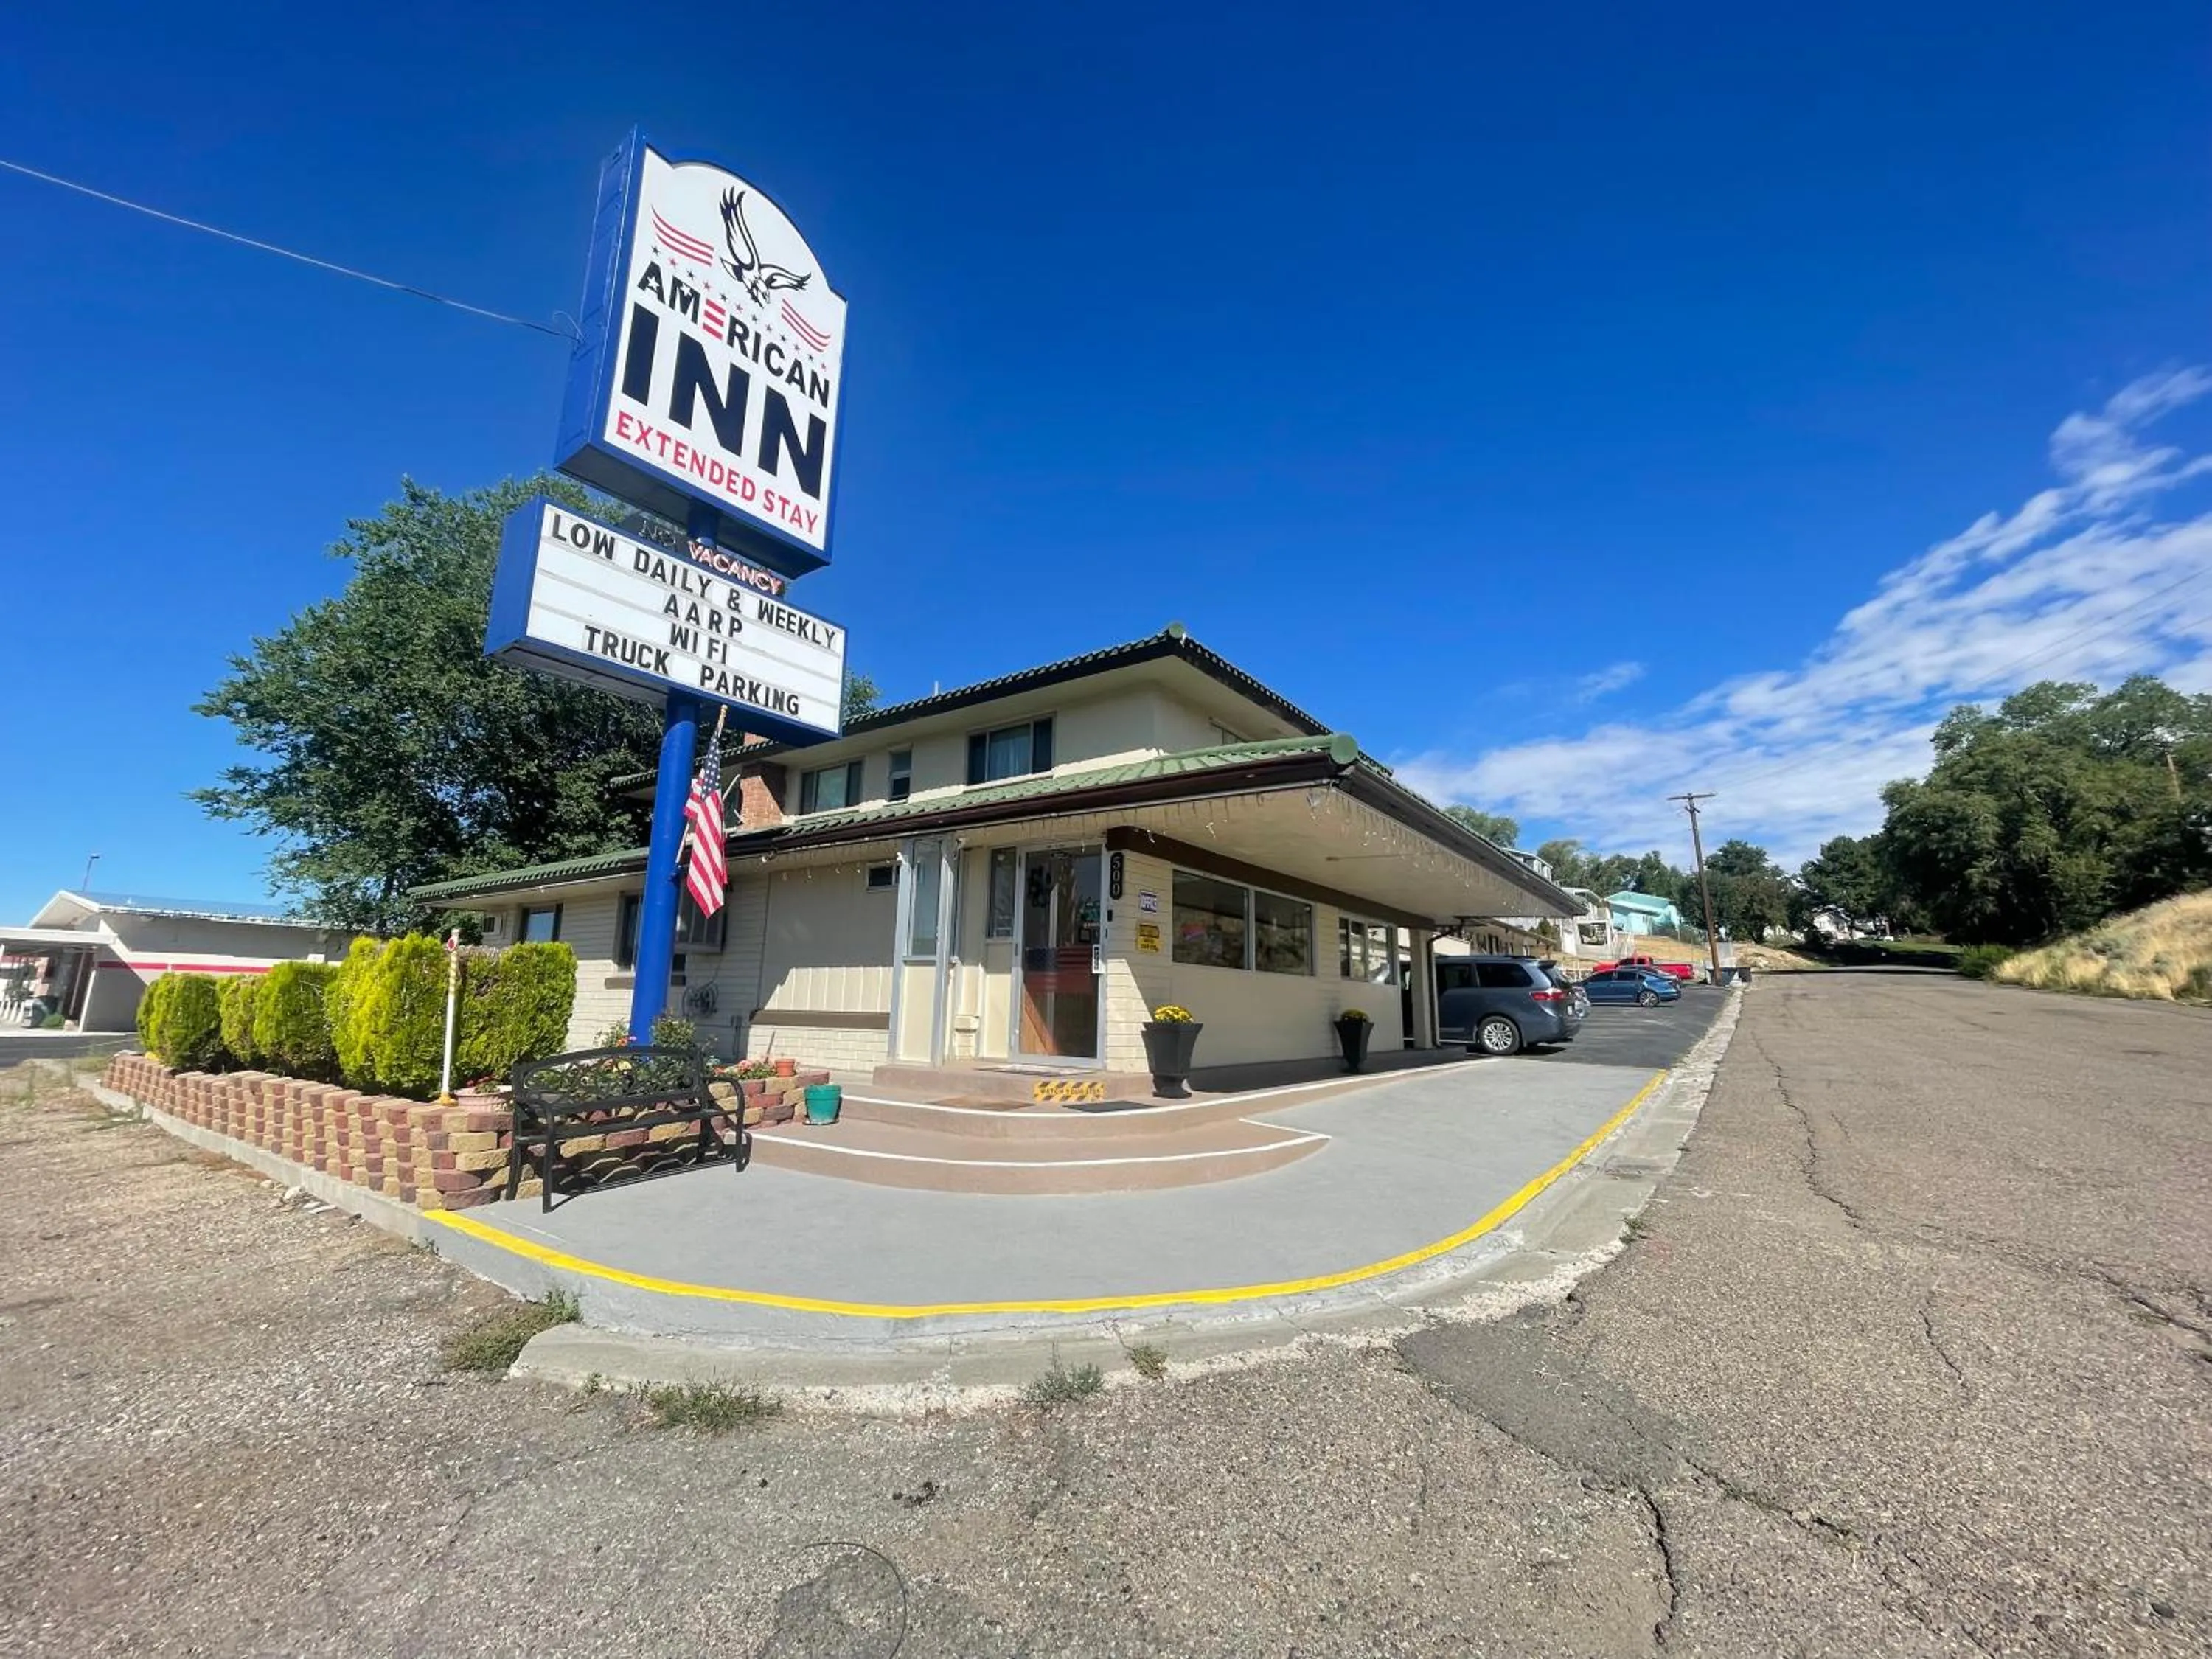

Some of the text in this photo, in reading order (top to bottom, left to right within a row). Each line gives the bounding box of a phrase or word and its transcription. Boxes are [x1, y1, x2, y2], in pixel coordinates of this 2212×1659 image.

[637, 261, 830, 408] AMERICAN
[622, 301, 827, 500] INN
[616, 410, 818, 535] EXTENDED STAY
[552, 512, 836, 650] LOW DAILY & WEEKLY
[664, 594, 743, 639] AARP
[687, 540, 784, 596] VACANCY
[584, 625, 799, 716] TRUCK PARKING
[1112, 856, 1121, 897] 500
